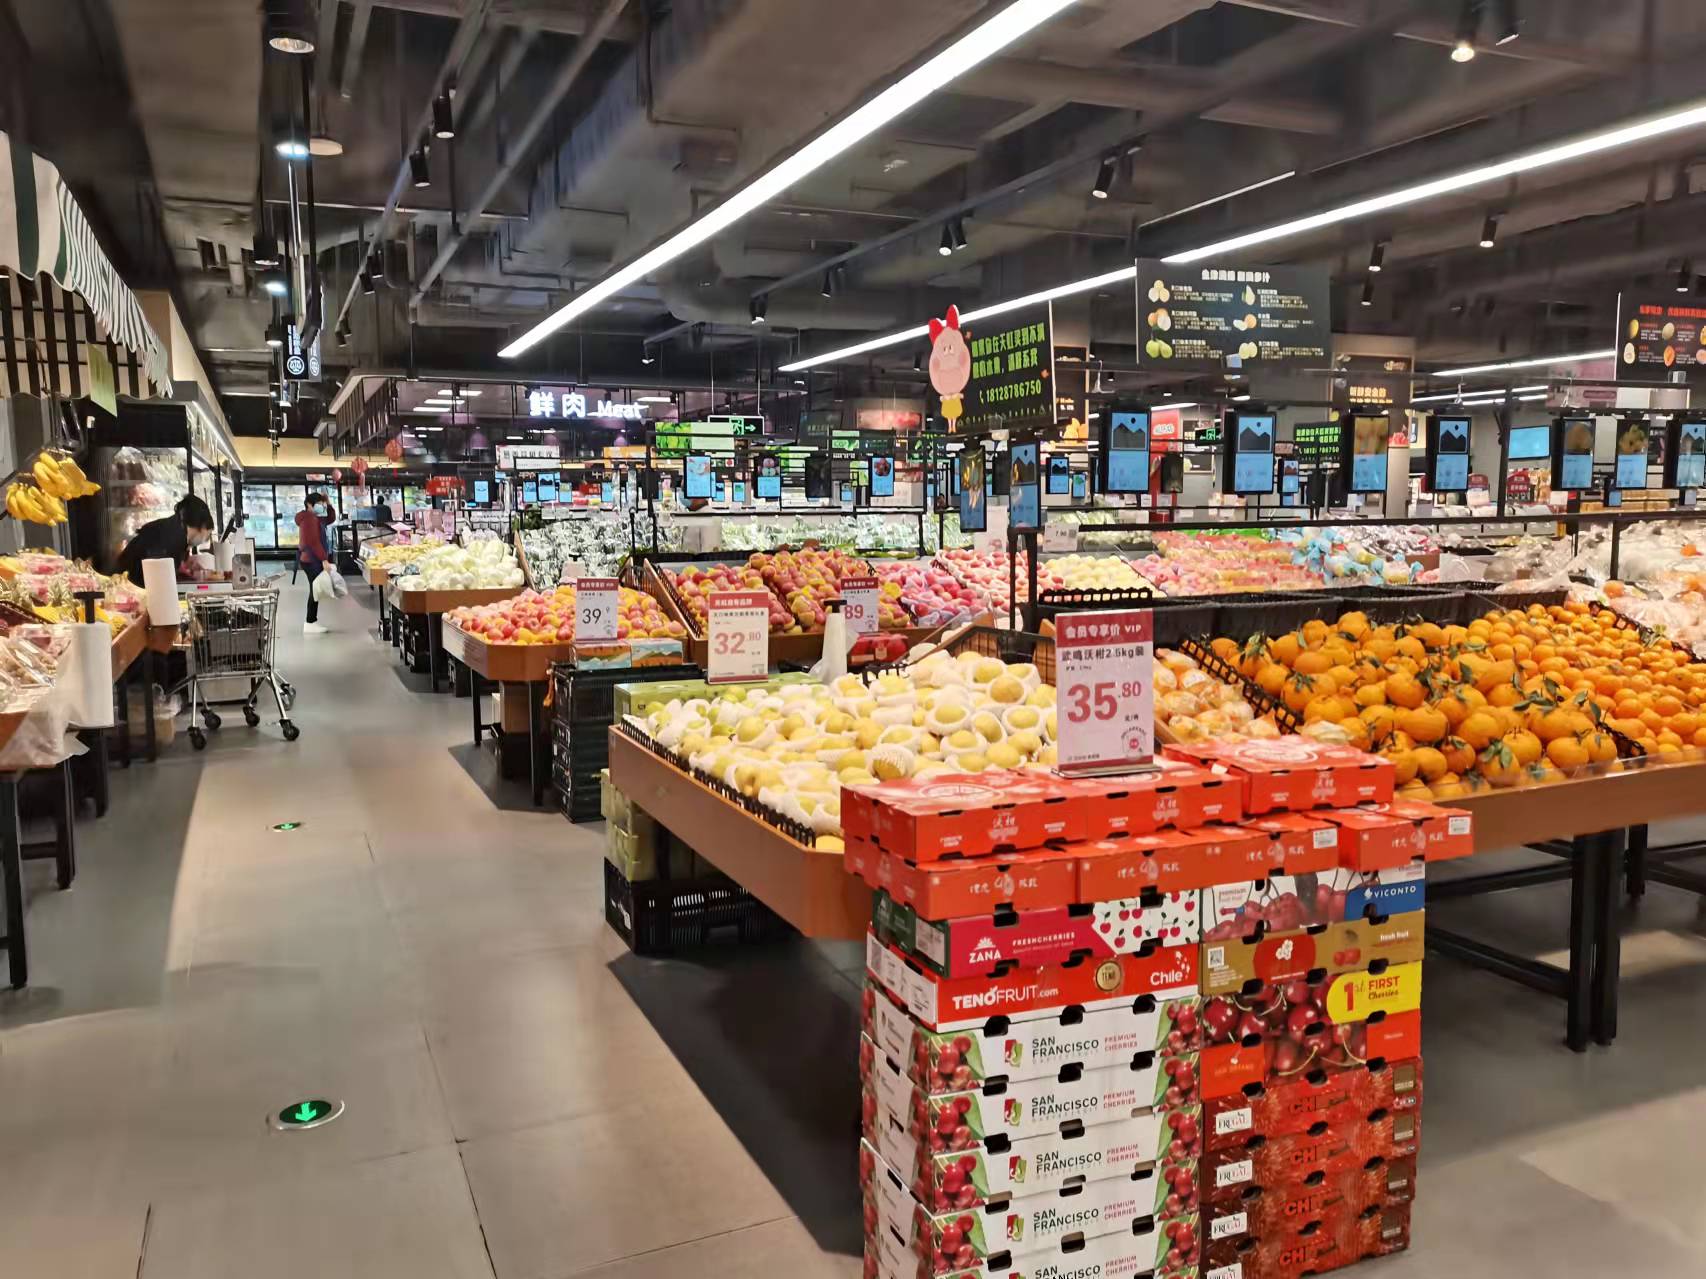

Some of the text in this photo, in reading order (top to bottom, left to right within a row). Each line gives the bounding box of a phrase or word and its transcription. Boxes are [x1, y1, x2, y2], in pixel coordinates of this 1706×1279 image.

[986, 379, 1041, 402] 18128786750
[529, 391, 647, 419] 鲜肉 Meat
[1065, 624, 1142, 639] 会员专享价 VIP
[1067, 680, 1142, 723] 35.80
[1374, 886, 1417, 899] VICONTO
[969, 951, 1002, 964] ZANA
[1150, 970, 1183, 986] Chile
[1368, 976, 1400, 990] FIRST
[952, 985, 1059, 1010] TENOFRUIT.com
[1032, 1036, 1056, 1049] SAN
[1105, 1033, 1137, 1043] PREMIUM
[1032, 1040, 1099, 1059] FRANCISCO
[1105, 1041, 1138, 1052] CHERRIES
[1031, 1094, 1055, 1107] SAN
[1103, 1089, 1135, 1100] PREMIUM
[1031, 1097, 1098, 1117] FRANCISCO
[1103, 1098, 1137, 1109] CHERRIES
[1107, 1143, 1139, 1155] PREMIUM
[1036, 1151, 1059, 1165] SAN
[1036, 1152, 1102, 1174] FRANCISCO
[1107, 1151, 1140, 1164] CHERRIES
[1104, 1200, 1136, 1212] PREMIUM
[1033, 1208, 1056, 1222] SAN
[1033, 1208, 1099, 1232] FRANCISCO
[1104, 1208, 1137, 1221] CHERRIES
[1105, 1255, 1137, 1268] PREMIUM
[1034, 1266, 1058, 1279] SAN
[1105, 1263, 1138, 1276] CHERRIES
